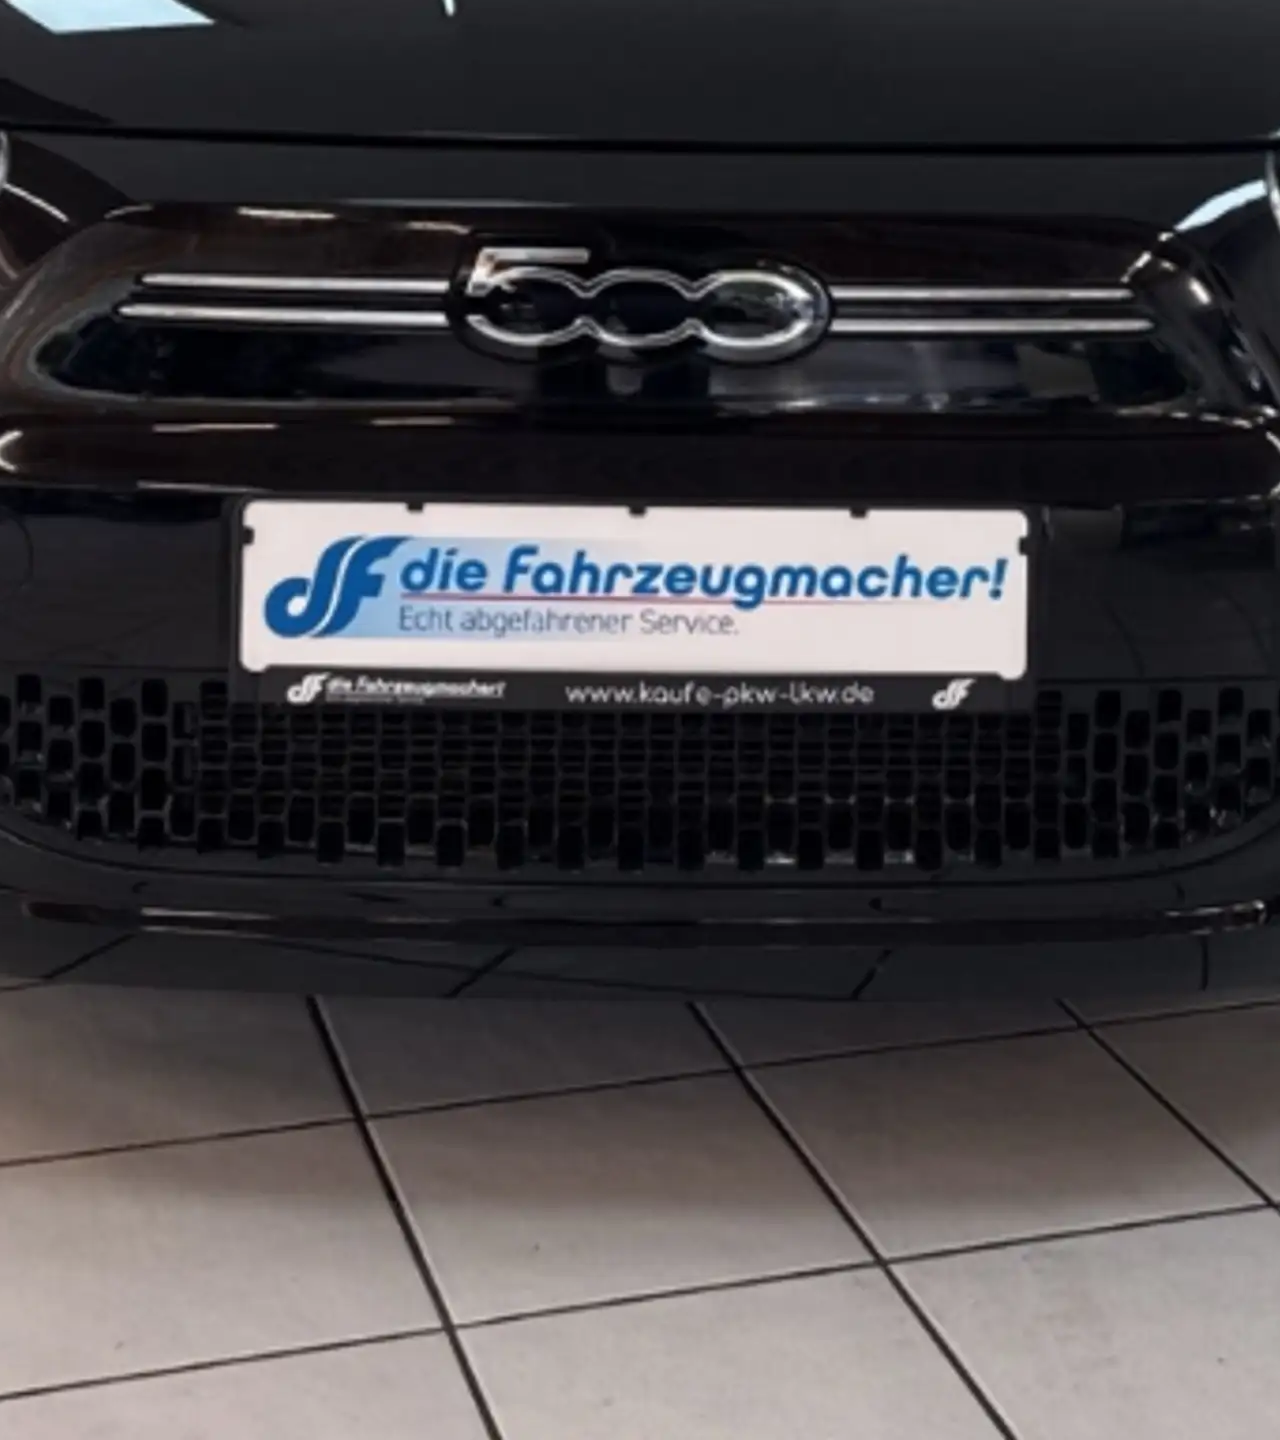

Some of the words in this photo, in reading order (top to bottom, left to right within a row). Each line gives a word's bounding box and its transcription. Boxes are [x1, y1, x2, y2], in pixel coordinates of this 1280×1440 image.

[465, 247, 813, 348] 500
[400, 547, 488, 591] die
[502, 545, 1009, 611] Fahrzeugmacher!
[398, 607, 452, 632] Echt
[459, 607, 632, 638] abgefahrener
[639, 611, 739, 636] Service.
[565, 679, 874, 709] www.kaufe-pkw-lkw.de
